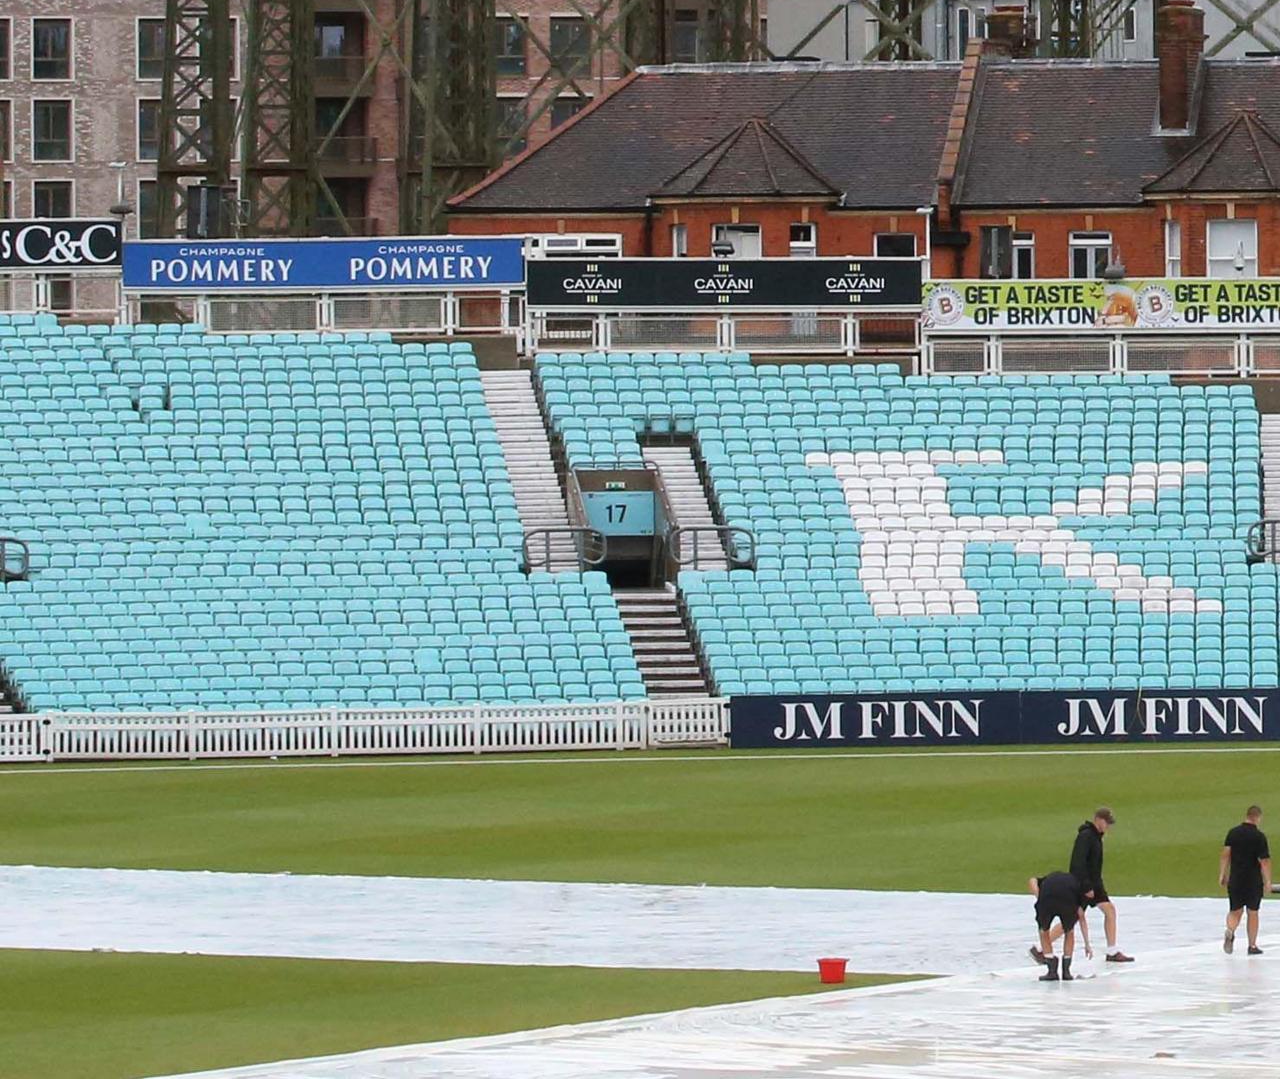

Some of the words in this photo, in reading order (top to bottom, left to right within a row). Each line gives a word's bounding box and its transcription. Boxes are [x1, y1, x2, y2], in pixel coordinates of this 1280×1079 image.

[15, 224, 117, 264] C&C
[179, 247, 265, 257] CHAMPAGNE
[378, 244, 464, 255] CHAMPAGNE
[151, 259, 293, 282] POMMERY
[350, 256, 492, 280] POMMERY
[563, 278, 622, 290] CAVANI
[694, 278, 754, 290] CAVANI
[825, 277, 885, 289] CAVANI
[964, 285, 1002, 305] GET
[1005, 286, 1020, 305] A
[1023, 285, 1084, 305] TASTE
[1174, 284, 1212, 303] GET
[1215, 284, 1230, 303] A
[973, 306, 1000, 325] OF
[1007, 305, 1096, 326] BRIXTON
[1183, 304, 1210, 324] OF
[605, 504, 627, 524] 17
[773, 702, 844, 740] JM
[858, 699, 984, 739] FINN
[1057, 698, 1129, 736] JM
[1140, 697, 1268, 736] FINN
